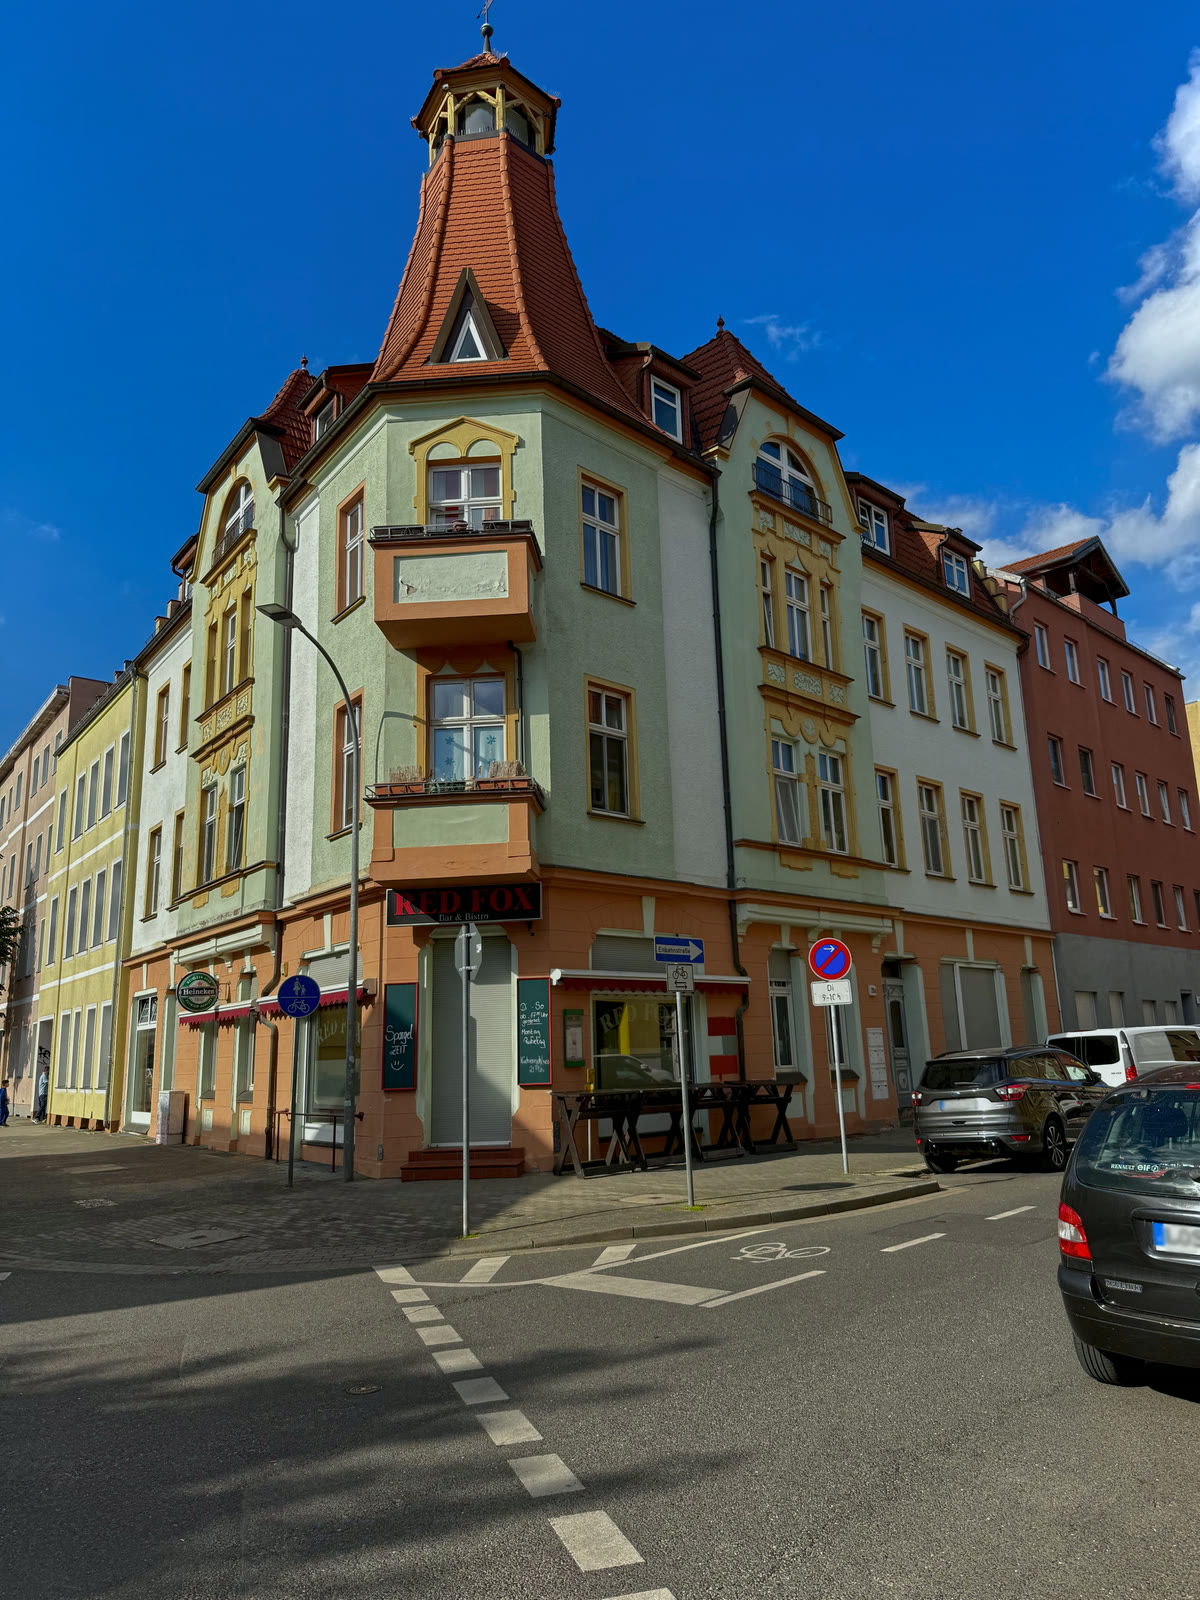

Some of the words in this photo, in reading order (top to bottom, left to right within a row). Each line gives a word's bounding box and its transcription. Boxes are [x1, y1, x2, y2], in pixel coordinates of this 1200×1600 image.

[394, 889, 461, 916] RED
[471, 887, 534, 913] FOX
[439, 914, 453, 922] Bar
[455, 913, 462, 921] &
[465, 912, 489, 920] Bistro
[658, 946, 690, 954] Einbahnstraße
[183, 988, 215, 996] Heineken
[826, 984, 835, 992] Di
[1110, 1163, 1136, 1171] RENAULT
